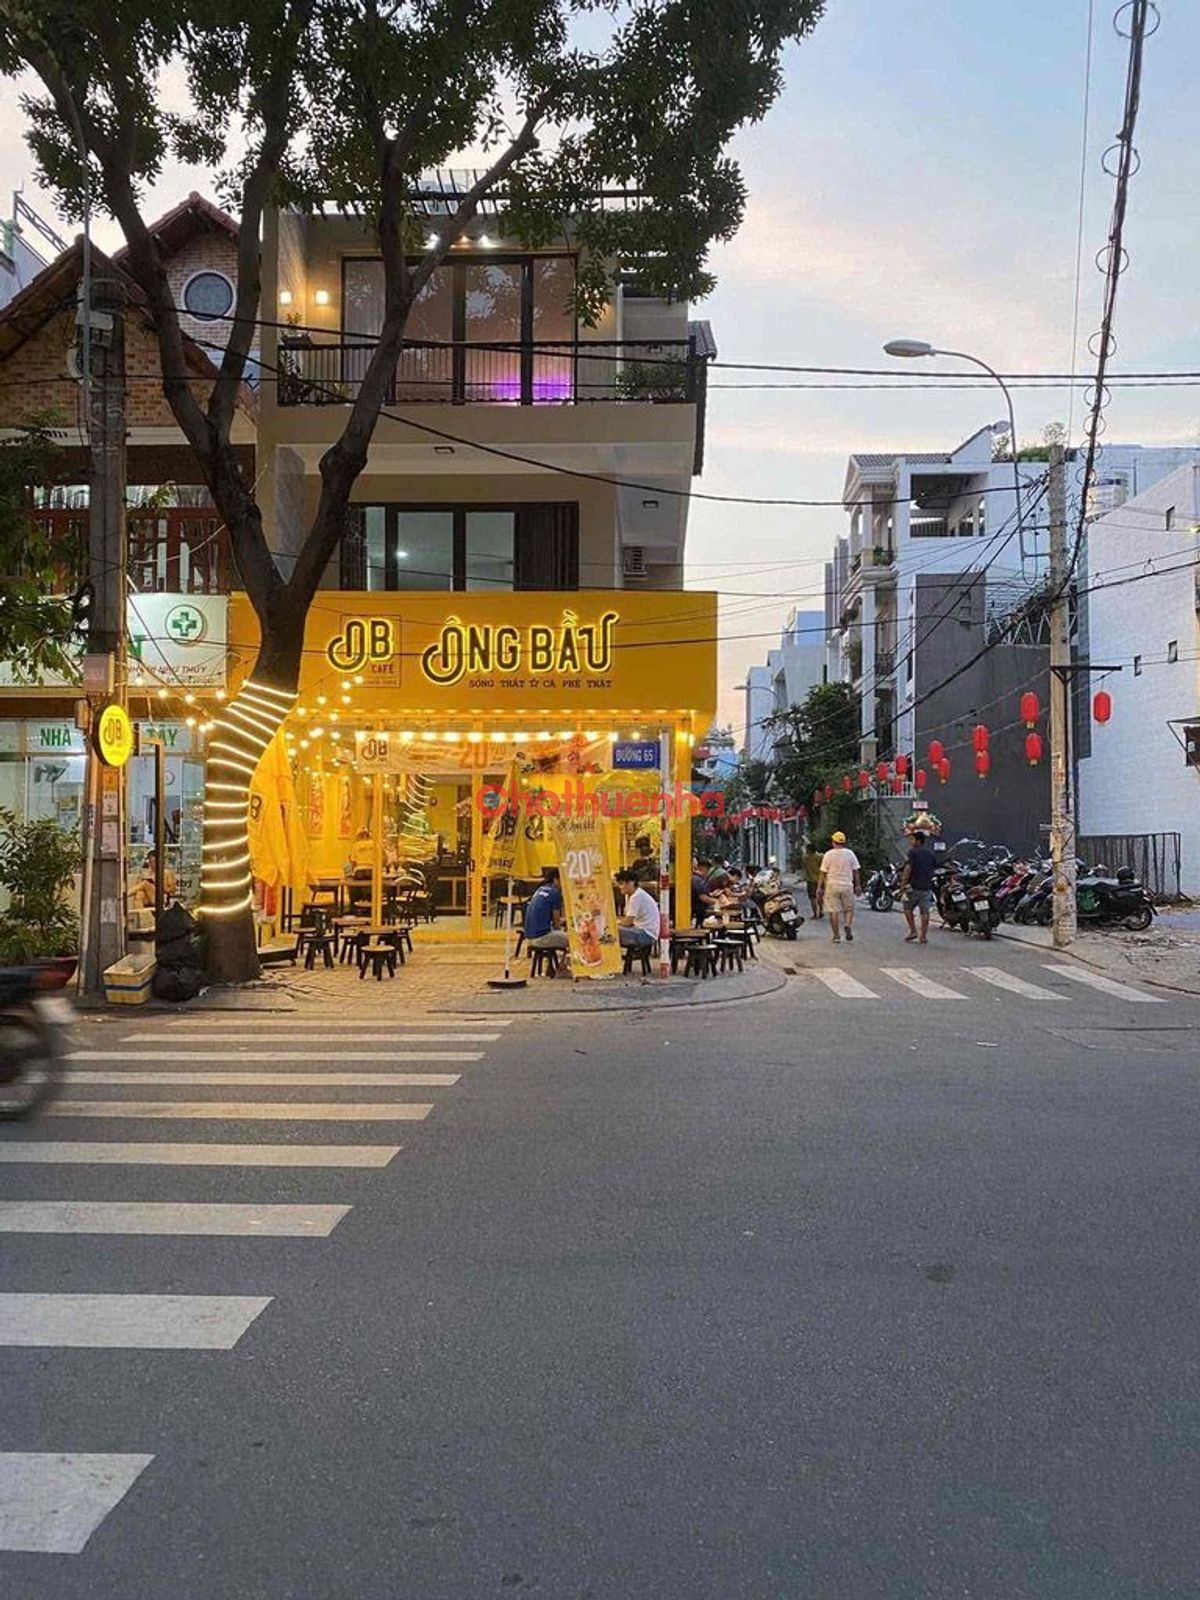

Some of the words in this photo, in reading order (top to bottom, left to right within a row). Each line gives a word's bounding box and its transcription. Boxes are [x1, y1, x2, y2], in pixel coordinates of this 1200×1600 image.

[326, 618, 393, 672] OB
[422, 617, 520, 685] ÔNG
[40, 724, 72, 747] NHÀ
[103, 718, 122, 746] OB
[361, 739, 388, 761] OB
[644, 749, 654, 762] 65
